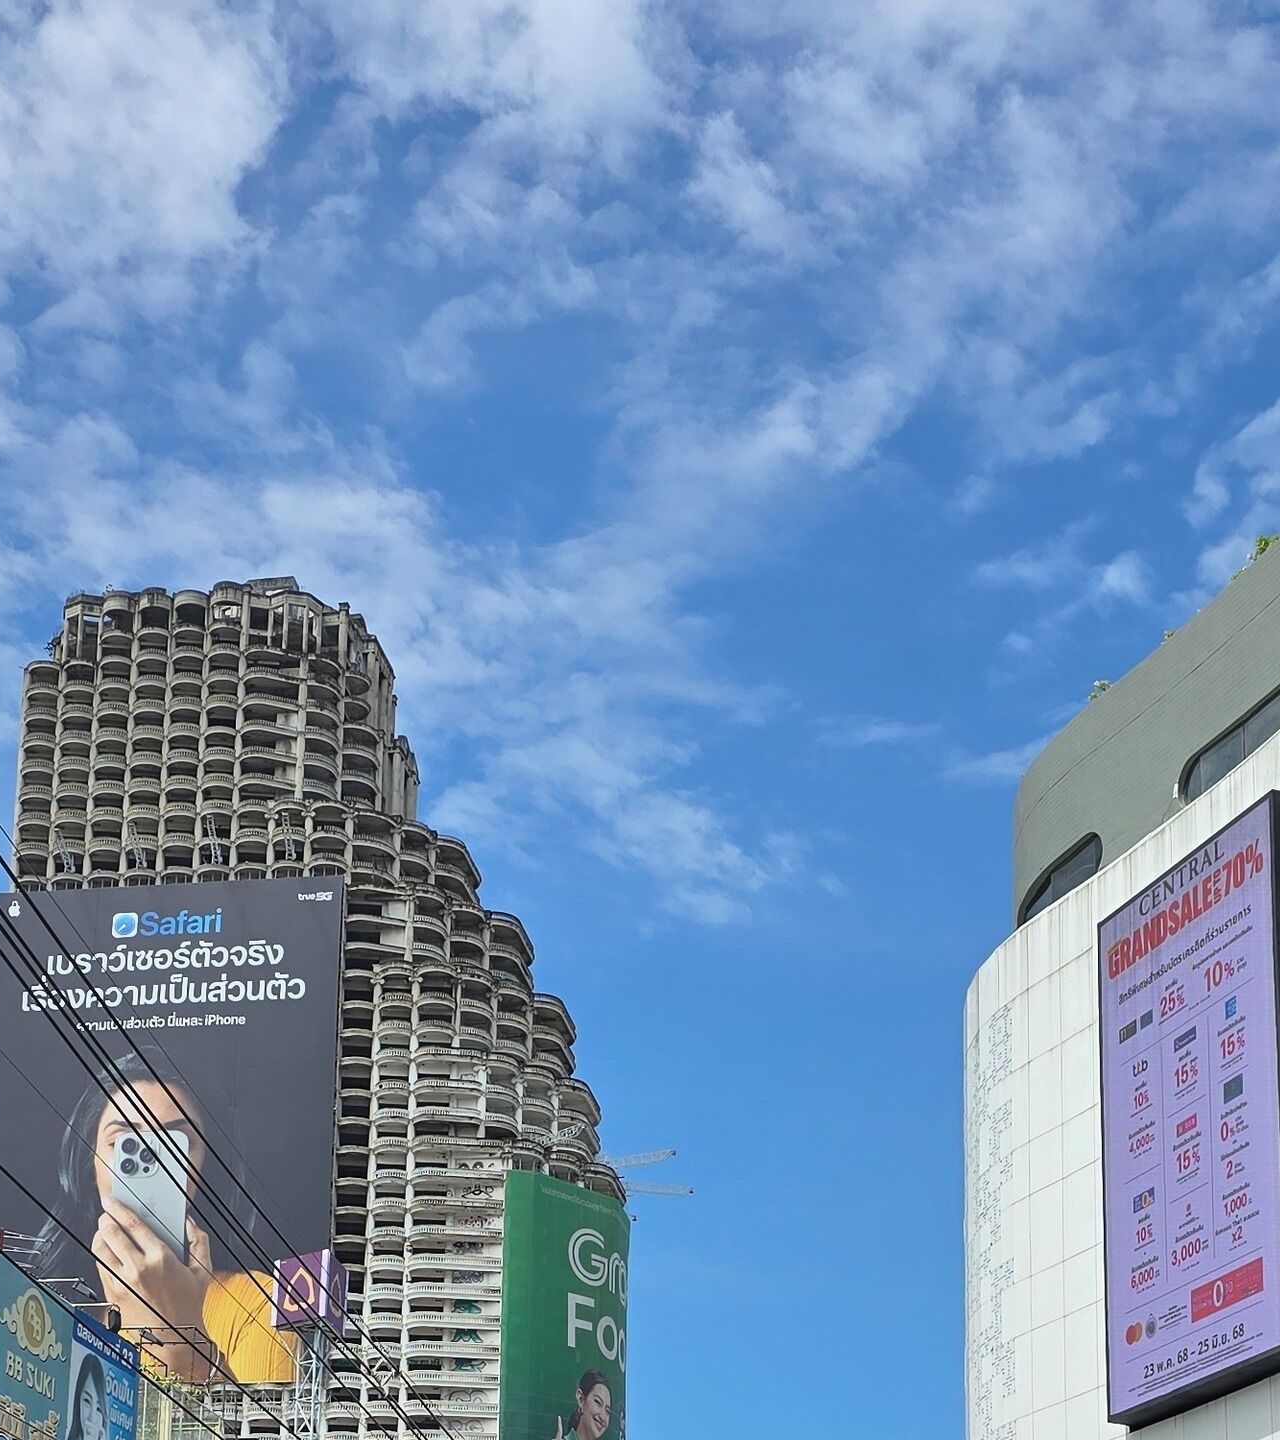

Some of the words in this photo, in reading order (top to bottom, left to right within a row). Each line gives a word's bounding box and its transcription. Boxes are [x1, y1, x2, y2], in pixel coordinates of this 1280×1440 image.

[1138, 840, 1225, 917] CENTRAL
[1222, 838, 1264, 897] 70%
[139, 907, 224, 937] Safari
[46, 938, 284, 976] เบราว์เซอร์ตัวจริง
[1204, 959, 1235, 993] 10%
[204, 1013, 246, 1027] iPhone
[1159, 991, 1185, 1018] 25%
[1220, 1033, 1246, 1060] 15%
[1171, 1237, 1201, 1268] 3,000
[1131, 1266, 1155, 1290] 6,000
[1143, 1363, 1155, 1379] 23
[1157, 1358, 1176, 1373] พ.ค.
[1177, 1347, 1189, 1364] 68
[1197, 1339, 1209, 1356] 25
[1232, 1322, 1245, 1338] 68
[5, 1349, 23, 1383] BB
[24, 1361, 57, 1402] SUKI
